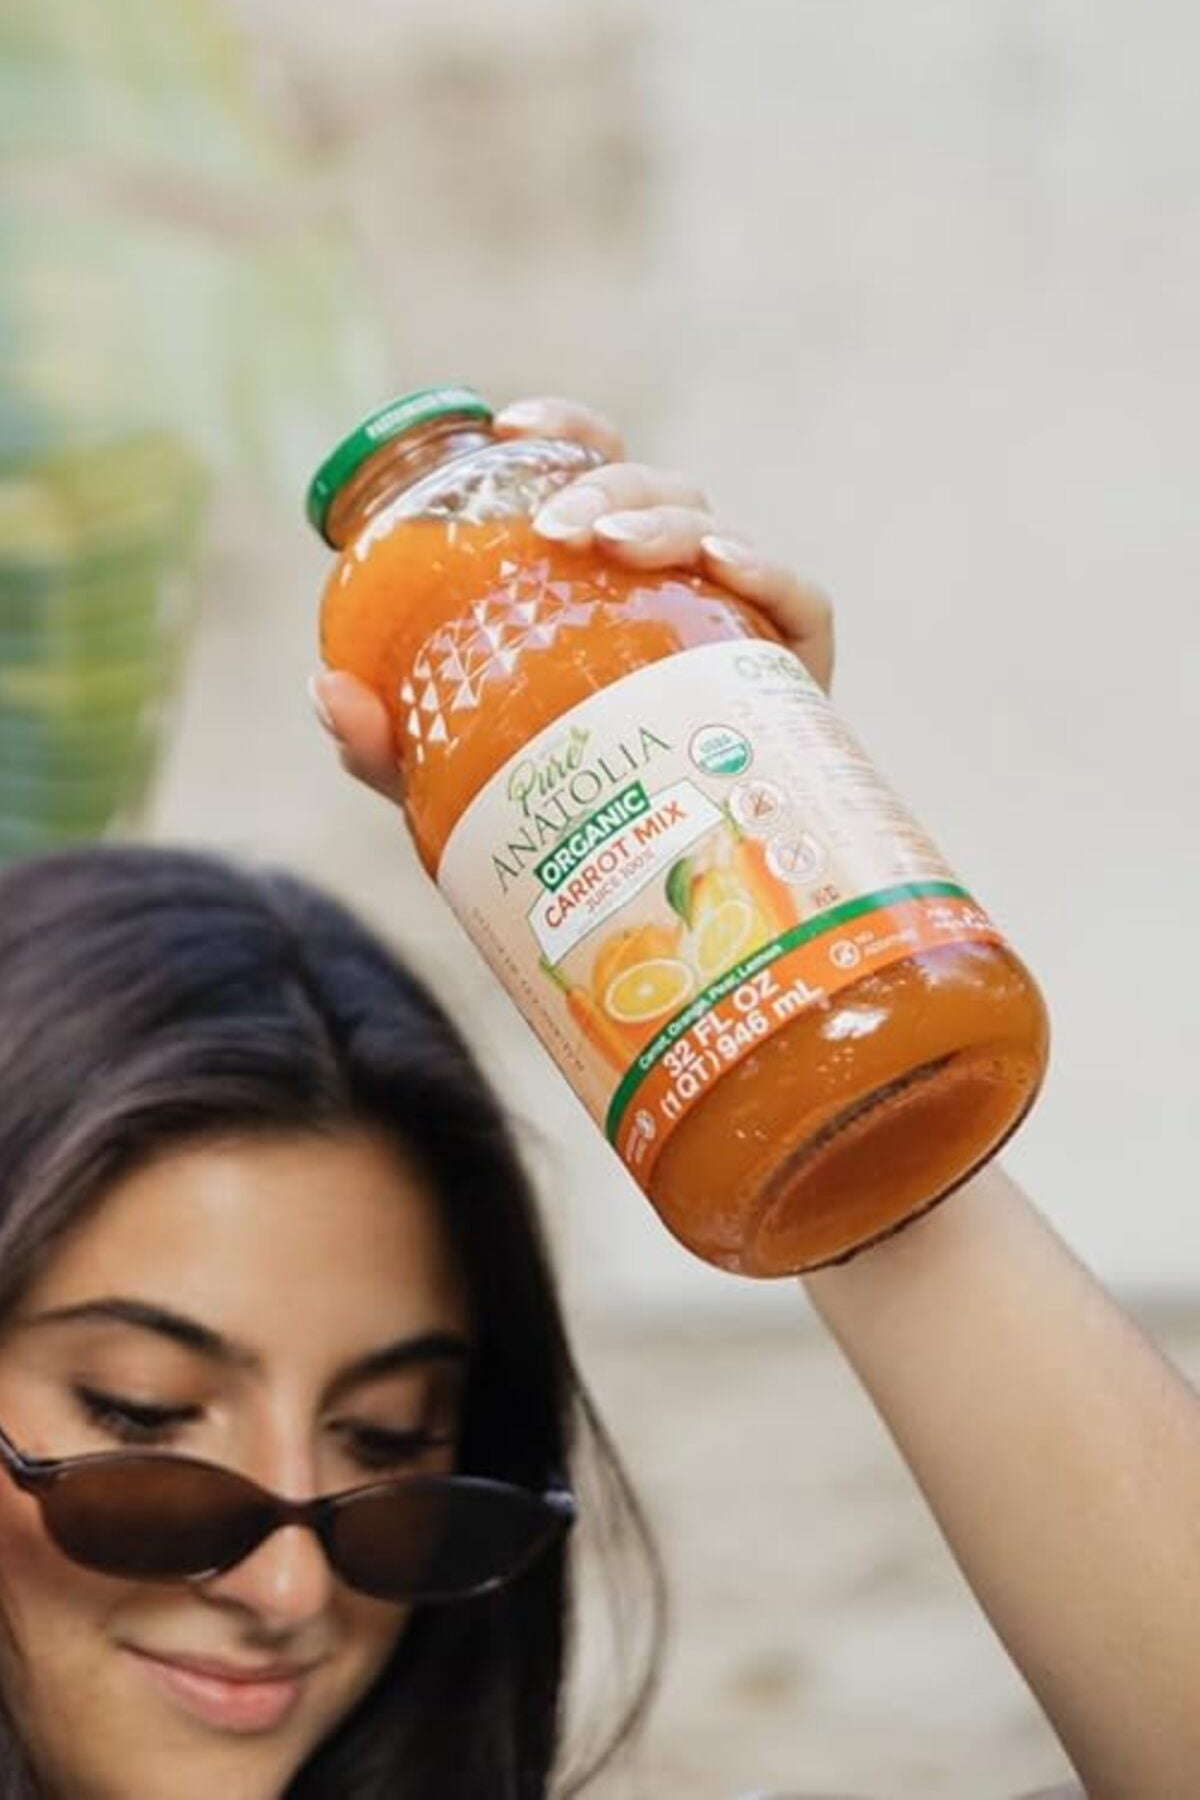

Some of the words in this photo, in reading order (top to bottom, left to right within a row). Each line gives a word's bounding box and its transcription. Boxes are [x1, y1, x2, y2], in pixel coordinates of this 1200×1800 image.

[490, 726, 671, 894] ANATOLIA
[540, 788, 647, 886] ORGANIC
[544, 840, 631, 928] CARROT
[633, 800, 687, 845] MIX
[663, 1040, 696, 1078] 32
[693, 1011, 735, 1047] FL
[733, 969, 780, 1012] OZ
[716, 1009, 769, 1060] 946
[772, 978, 824, 1019] mL
